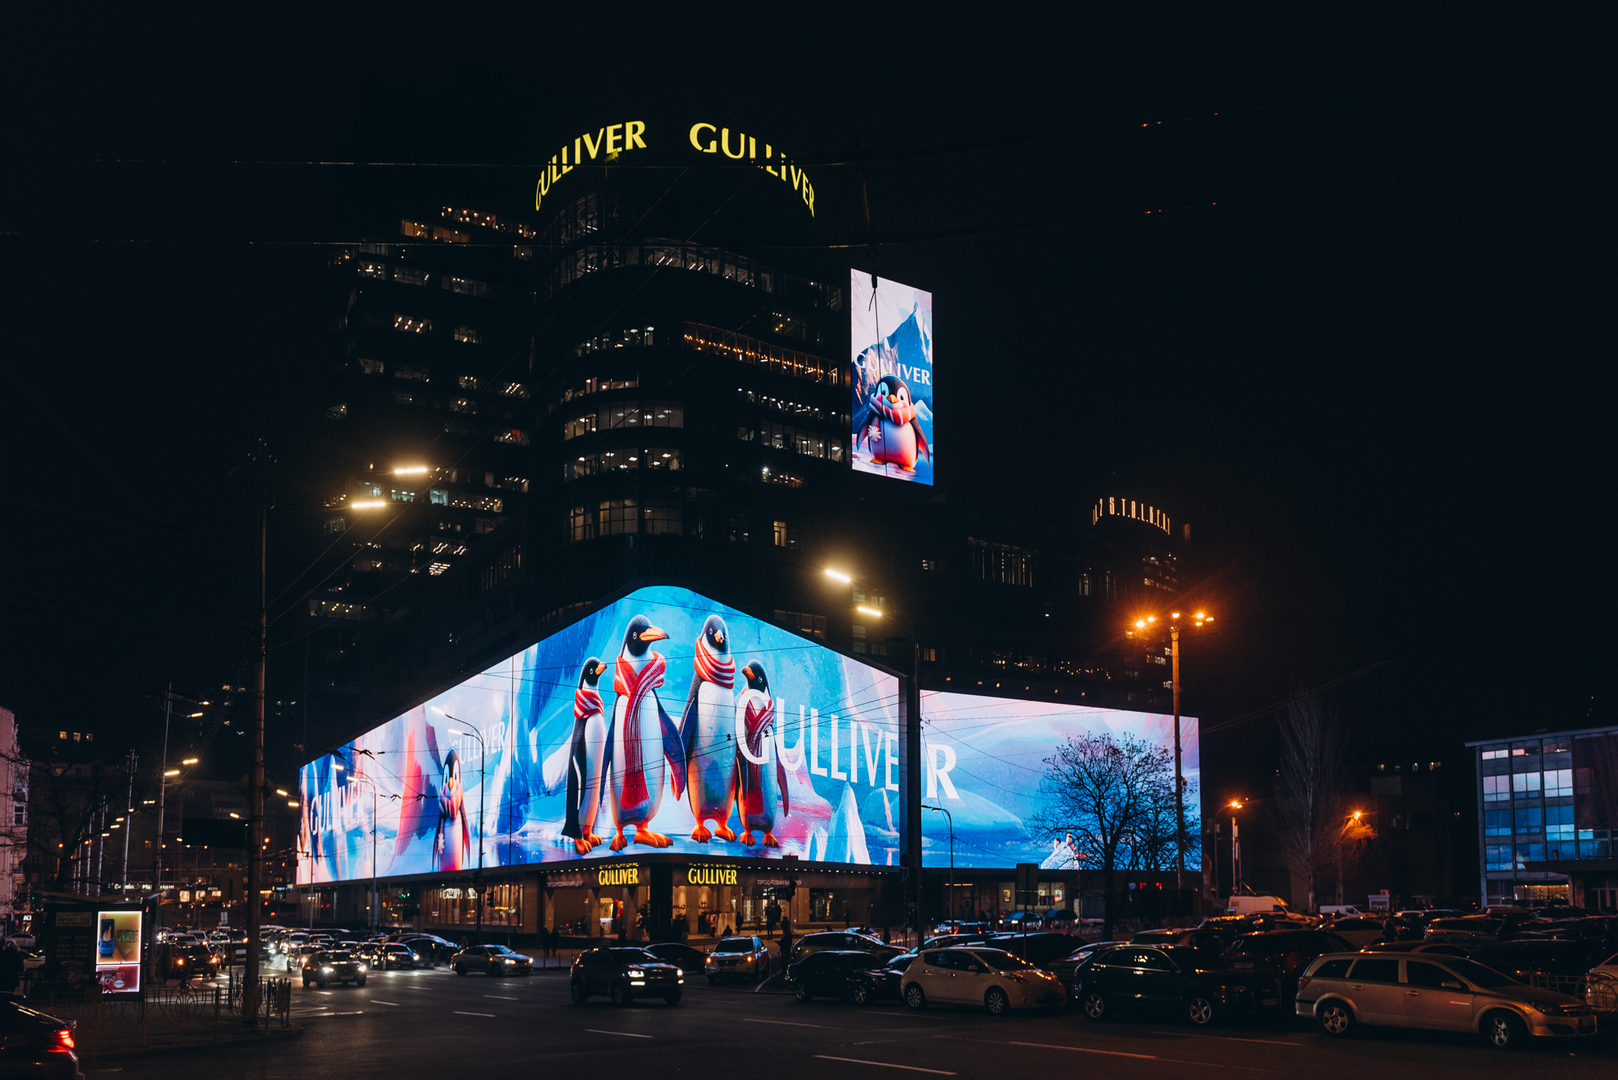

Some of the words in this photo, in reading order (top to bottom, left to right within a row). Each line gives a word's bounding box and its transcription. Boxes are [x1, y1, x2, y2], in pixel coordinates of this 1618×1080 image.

[535, 120, 647, 211] GULLIVER
[689, 122, 815, 217] GULLIVER
[310, 780, 365, 836] GULIVER
[598, 868, 639, 886] GULLIVER
[688, 868, 737, 885] GULLIVER
